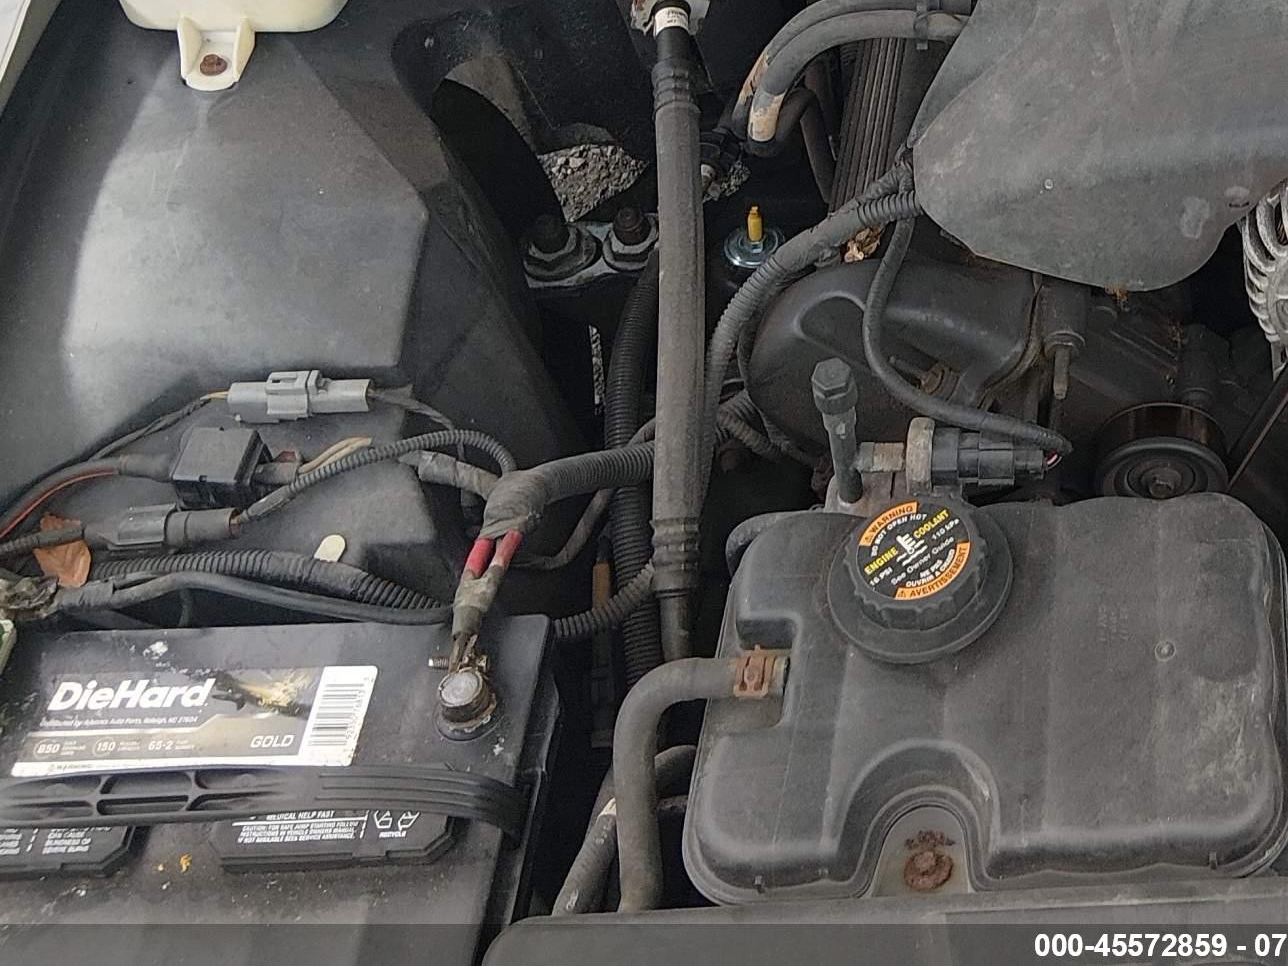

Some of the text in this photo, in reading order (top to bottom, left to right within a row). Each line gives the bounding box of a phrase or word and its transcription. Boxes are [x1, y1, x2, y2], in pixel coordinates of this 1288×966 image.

[871, 506, 913, 533] WARNING
[871, 545, 878, 556] DO
[875, 530, 887, 544] NOT
[887, 516, 908, 530] OPEN
[864, 510, 949, 574] ENGINE COOLANT
[870, 519, 959, 586] 16 PSI 110 kPa
[891, 537, 954, 584] See Owner Guide
[910, 547, 966, 597] AVERTISSEMENT
[47, 678, 216, 711] DieHard
[38, 743, 60, 754] 850
[97, 742, 115, 751] 150
[250, 734, 295, 748] GOLD
